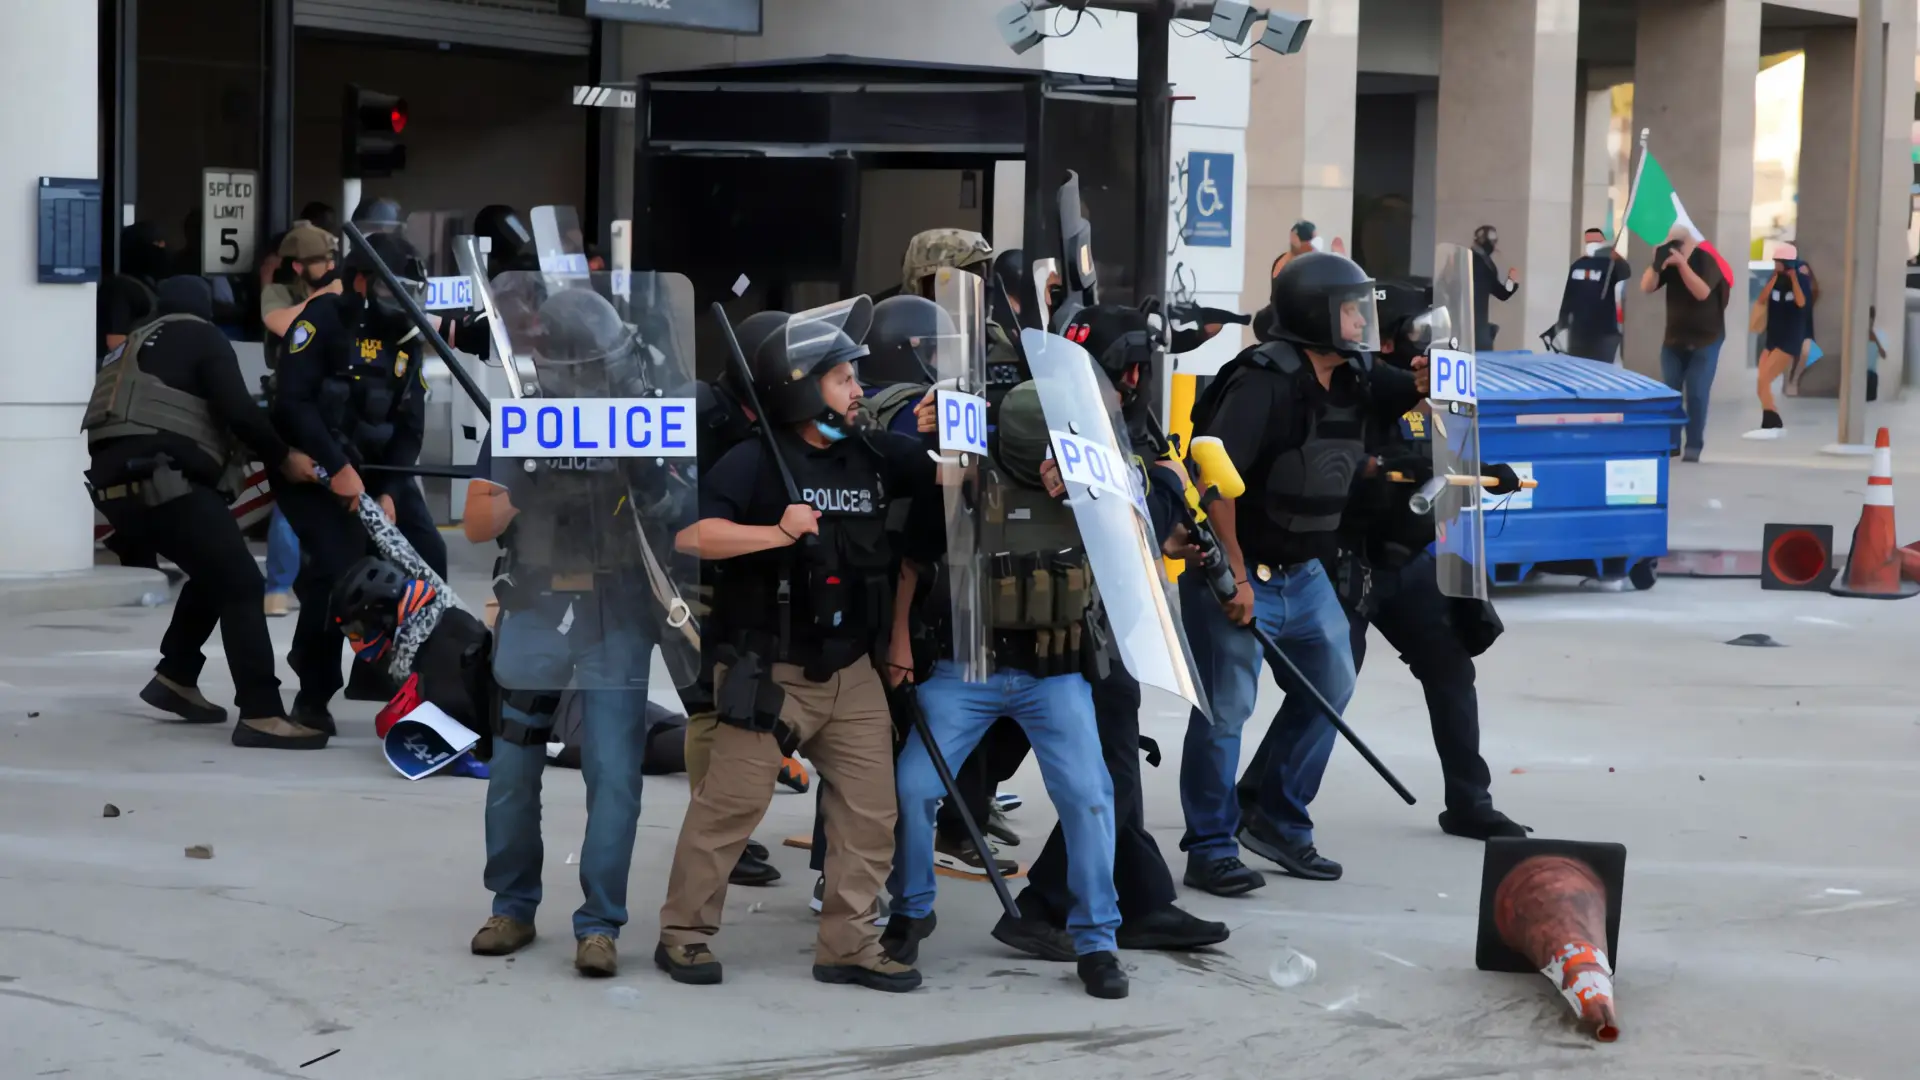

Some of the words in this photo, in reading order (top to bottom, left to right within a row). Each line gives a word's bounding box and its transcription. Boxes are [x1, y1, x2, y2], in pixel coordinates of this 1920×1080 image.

[208, 182, 252, 198] SPEED
[220, 228, 240, 265] 5
[502, 405, 686, 449] POLICE
[802, 488, 860, 512] POLICE
